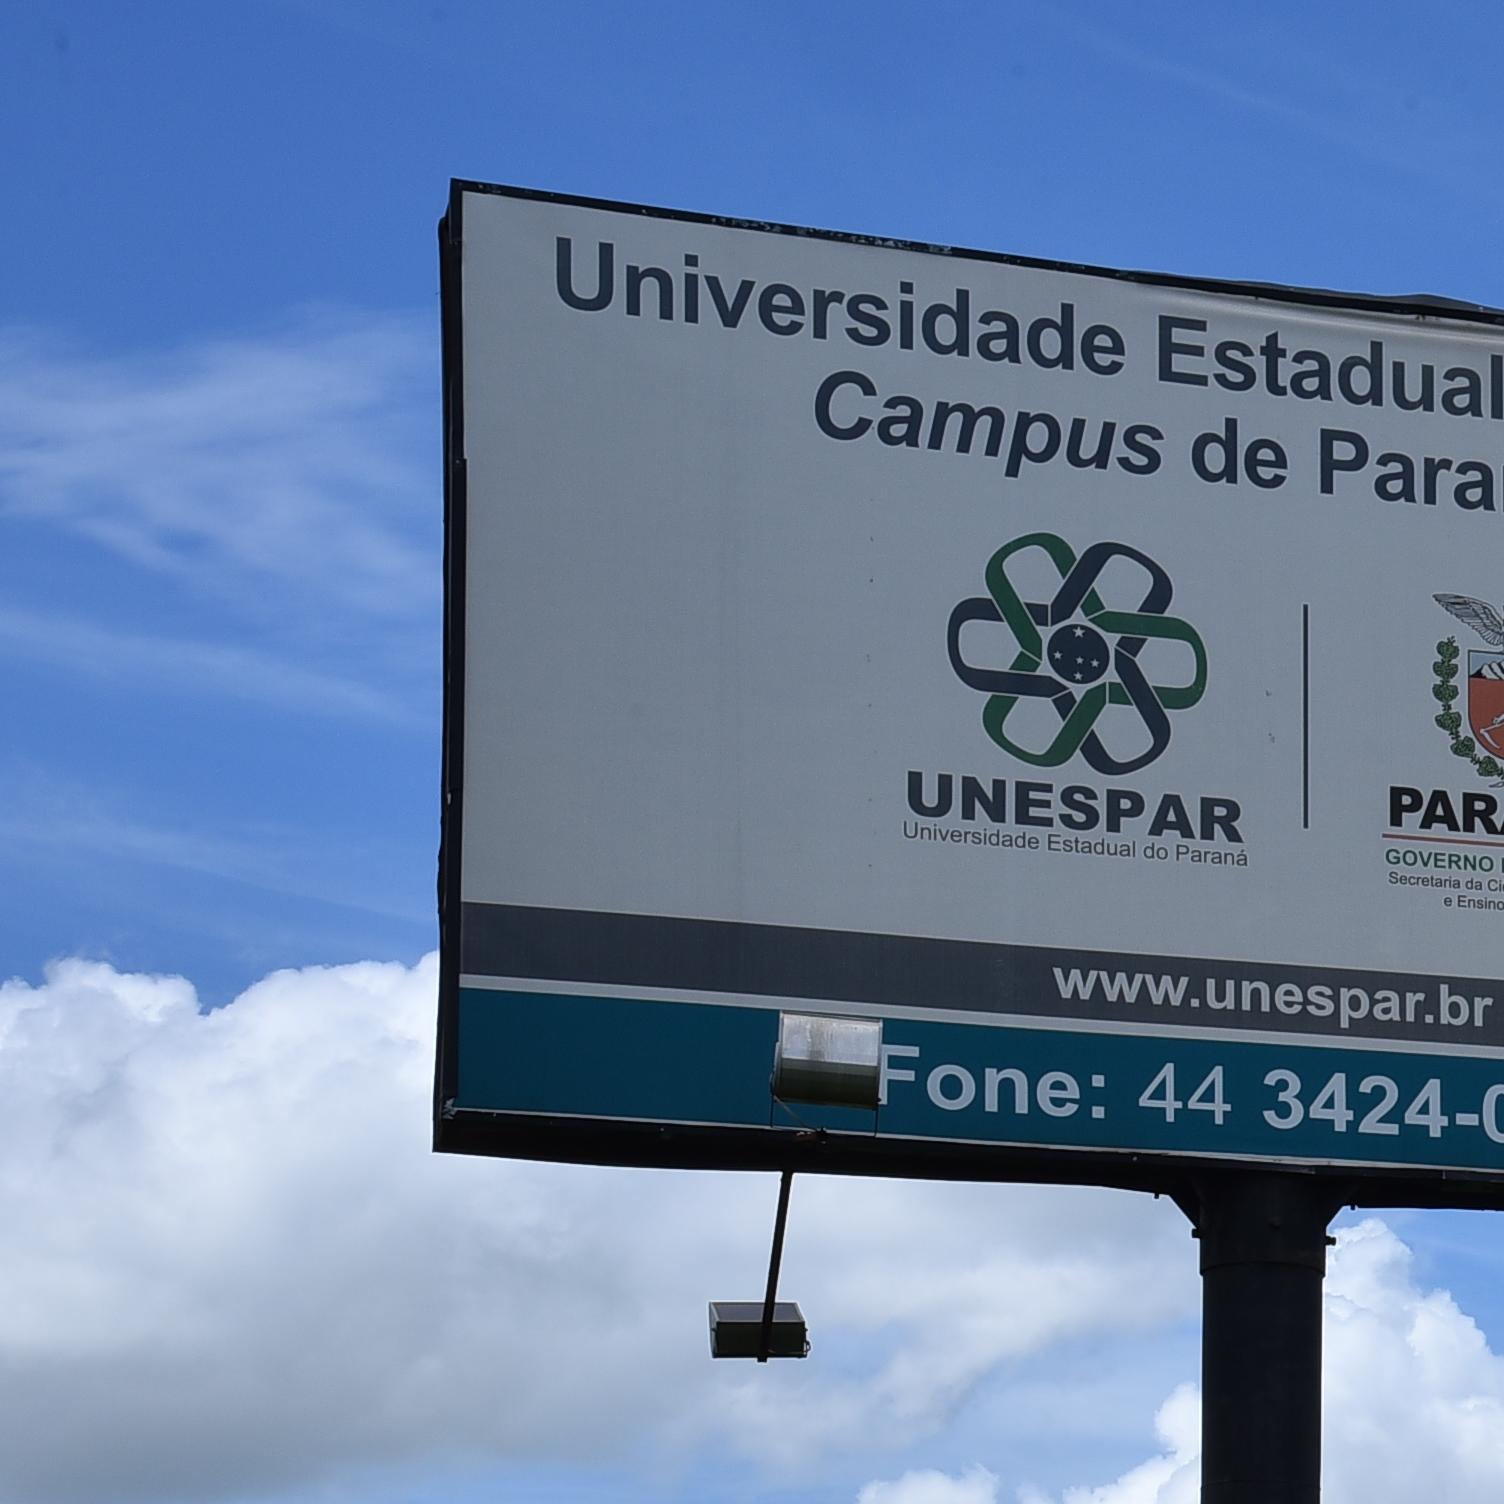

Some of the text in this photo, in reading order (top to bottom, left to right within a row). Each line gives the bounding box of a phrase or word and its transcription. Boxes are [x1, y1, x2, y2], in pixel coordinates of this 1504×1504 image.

[555, 236, 1125, 375] Universidade
[1158, 315, 1504, 420] Estadual
[814, 370, 1164, 479] Campus
[1190, 417, 1289, 489] de
[907, 770, 1244, 843] UNESPAR
[903, 820, 1249, 867] Universidade Estadual do Paraná
[1385, 848, 1494, 873] GOVERNO
[1388, 871, 1461, 890] Secretaria
[1465, 876, 1483, 891] da
[1443, 897, 1453, 907] e
[1052, 964, 1494, 1029] www.unespar.br
[880, 1043, 1107, 1120] Fone:
[1138, 1062, 1233, 1126] 44
